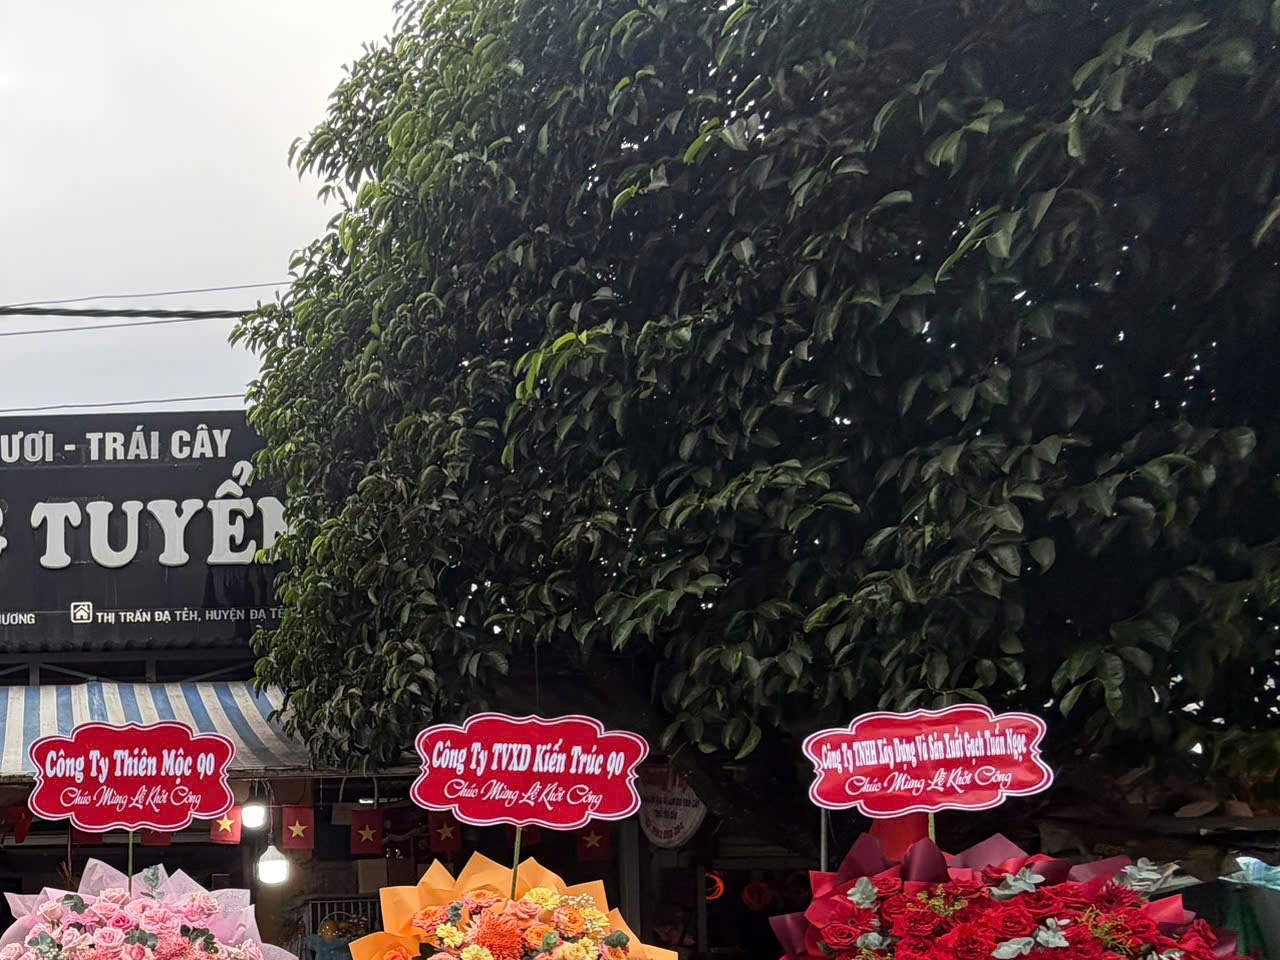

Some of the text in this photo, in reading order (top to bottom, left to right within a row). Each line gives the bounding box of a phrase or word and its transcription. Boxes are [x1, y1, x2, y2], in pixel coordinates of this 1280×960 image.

[86, 425, 159, 461] TRÁI
[171, 424, 232, 459] CÂY
[45, 747, 215, 785] Công Ty Thiên Mộc 90
[432, 740, 467, 776] Công
[470, 742, 488, 776] Ty
[491, 743, 531, 772] TVXD
[533, 738, 566, 774] Kiến
[569, 745, 604, 776] Trúc
[822, 742, 842, 774] Công
[841, 742, 853, 774] Ty
[853, 740, 878, 766] TNHH
[444, 778, 603, 811] Chúc Mừng Lễ Khởi Công
[845, 765, 1013, 796] Chúc Mừng Lễ Khởi Công
[60, 784, 202, 812] Chúc Mừng Lễ Khởi Công
